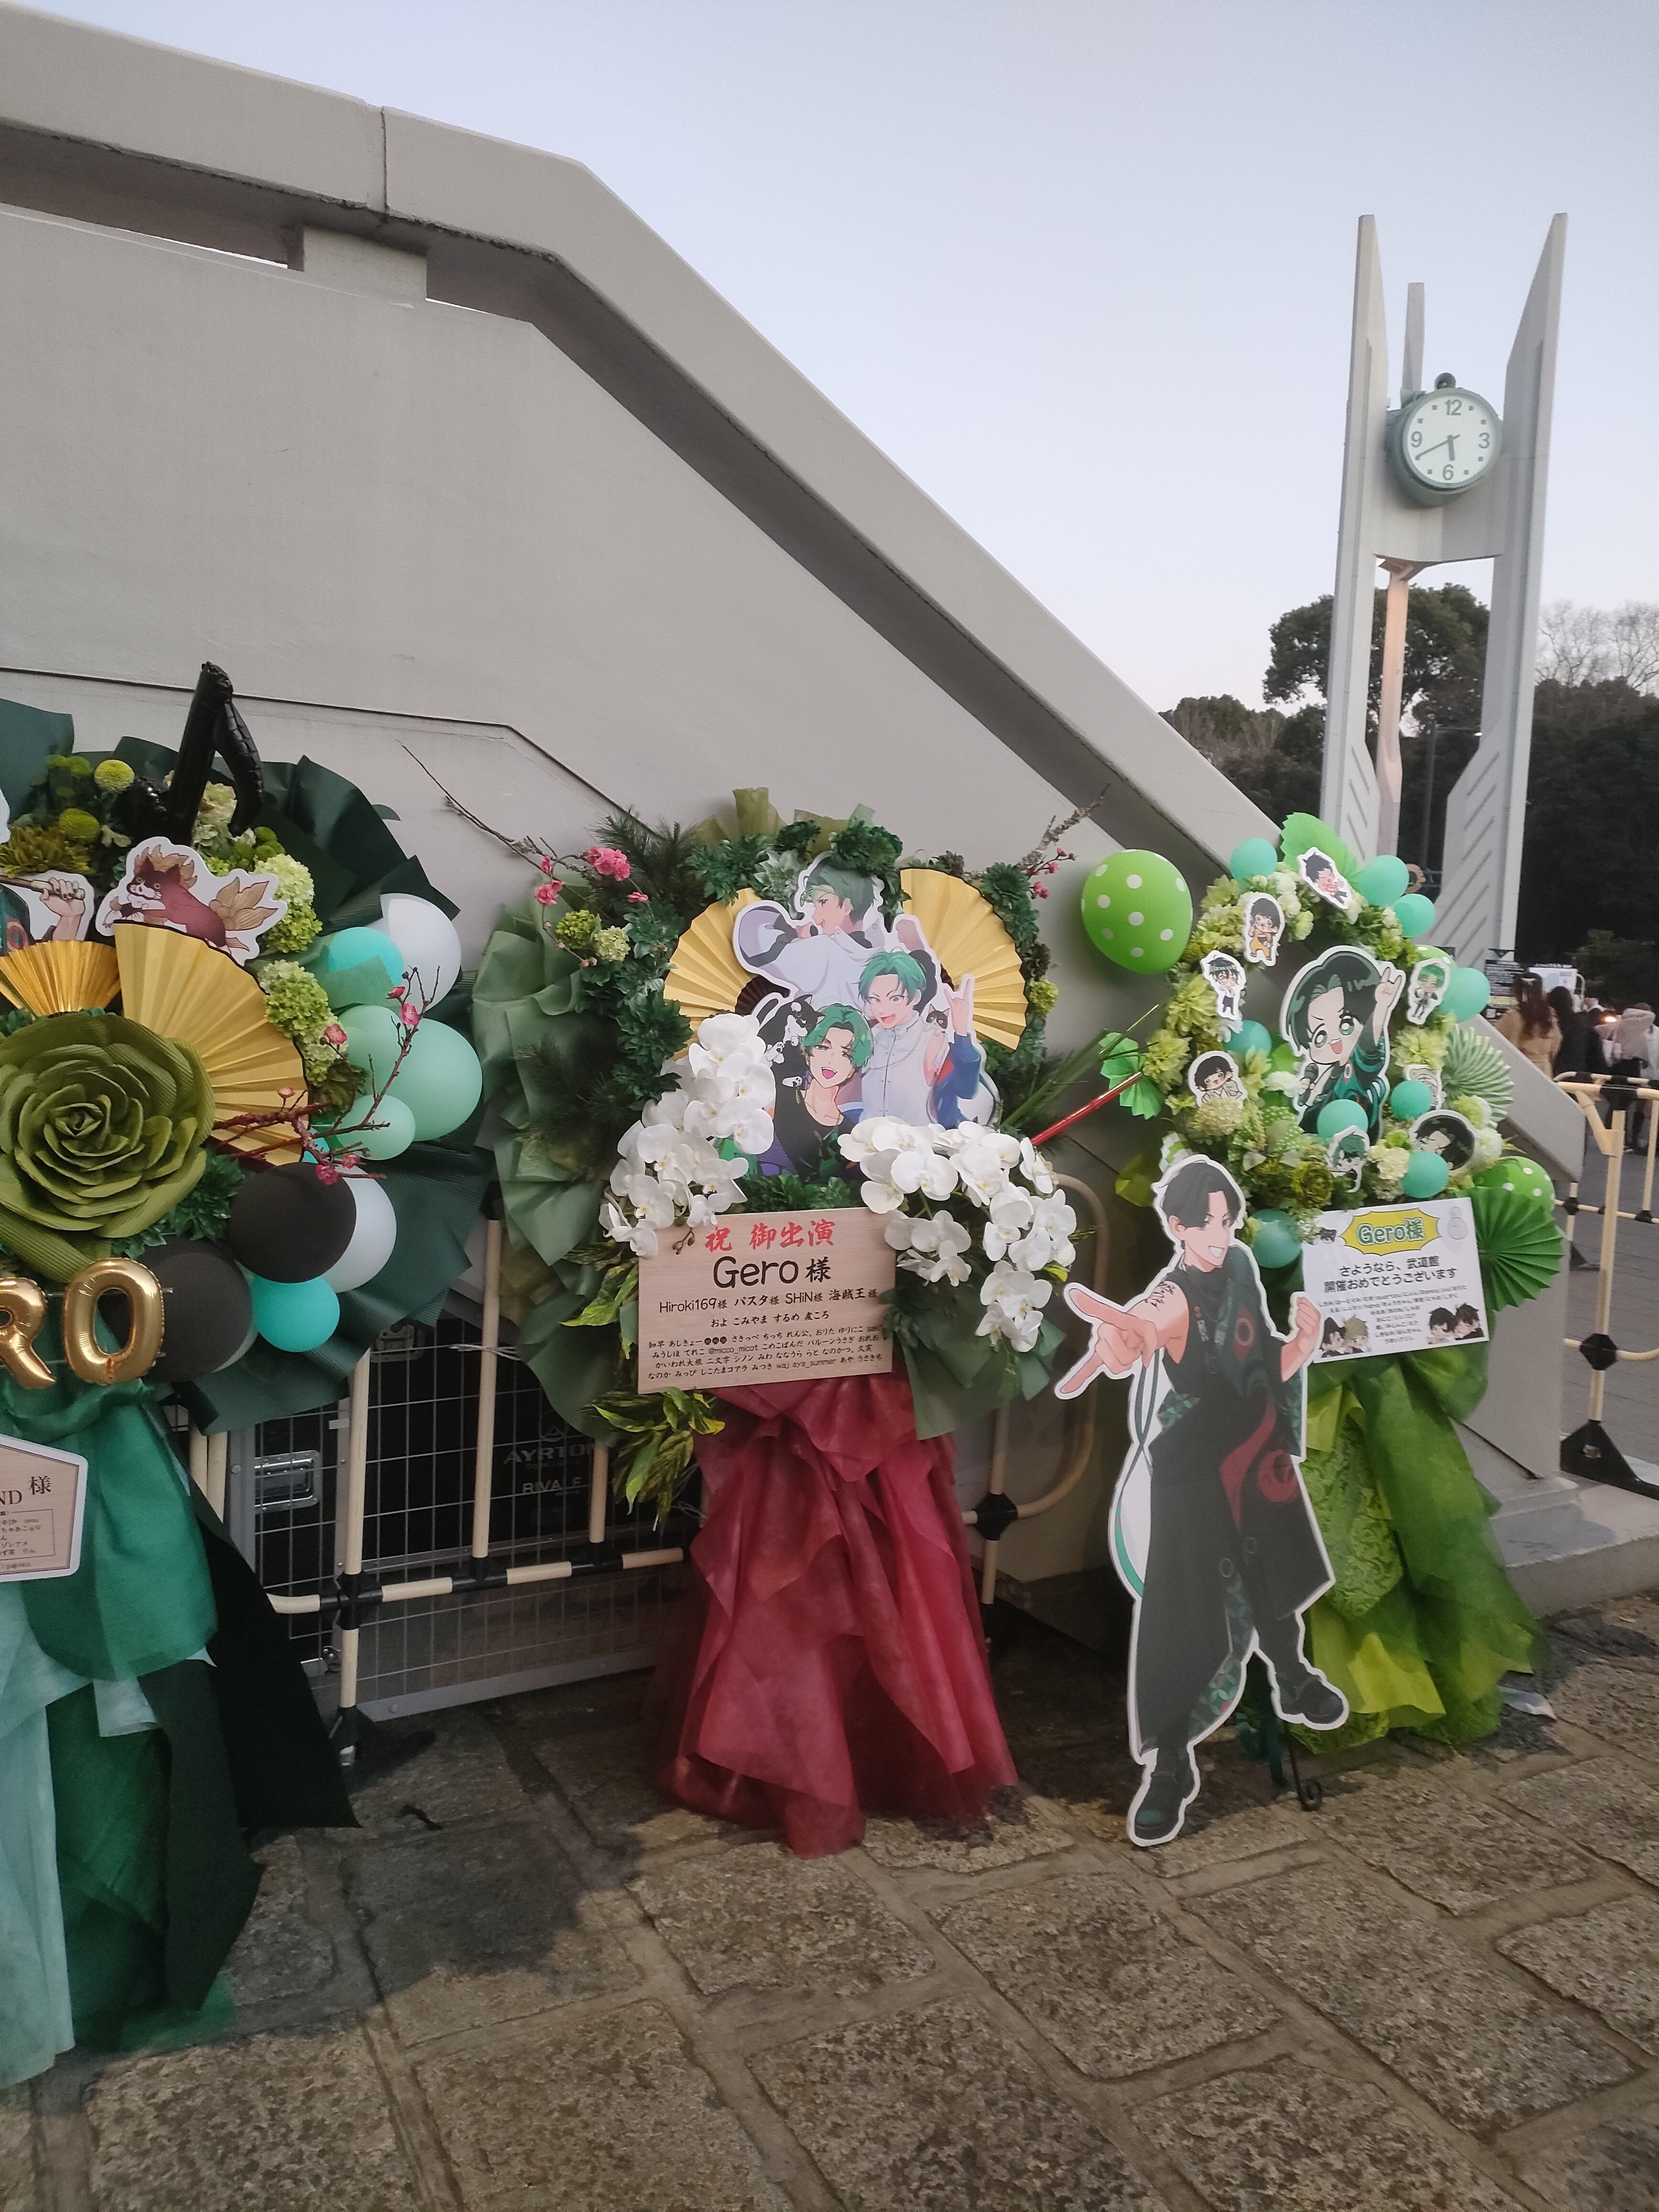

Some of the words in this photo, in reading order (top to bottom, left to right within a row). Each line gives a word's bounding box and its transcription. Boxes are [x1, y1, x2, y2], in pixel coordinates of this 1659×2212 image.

[1445, 399, 1462, 416] 12
[1411, 431, 1423, 448] 9
[1479, 432, 1490, 449] 3
[1442, 464, 1454, 481] 6
[704, 1227, 732, 1252] 祝
[750, 1218, 835, 1250] 御出演
[1324, 1268, 1458, 1293] 開催おめでとうございます
[734, 1315, 768, 1326] こみやま
[773, 1313, 800, 1323] するめ
[28, 1475, 52, 1495] 様
[521, 1476, 583, 1493] RIVAE
